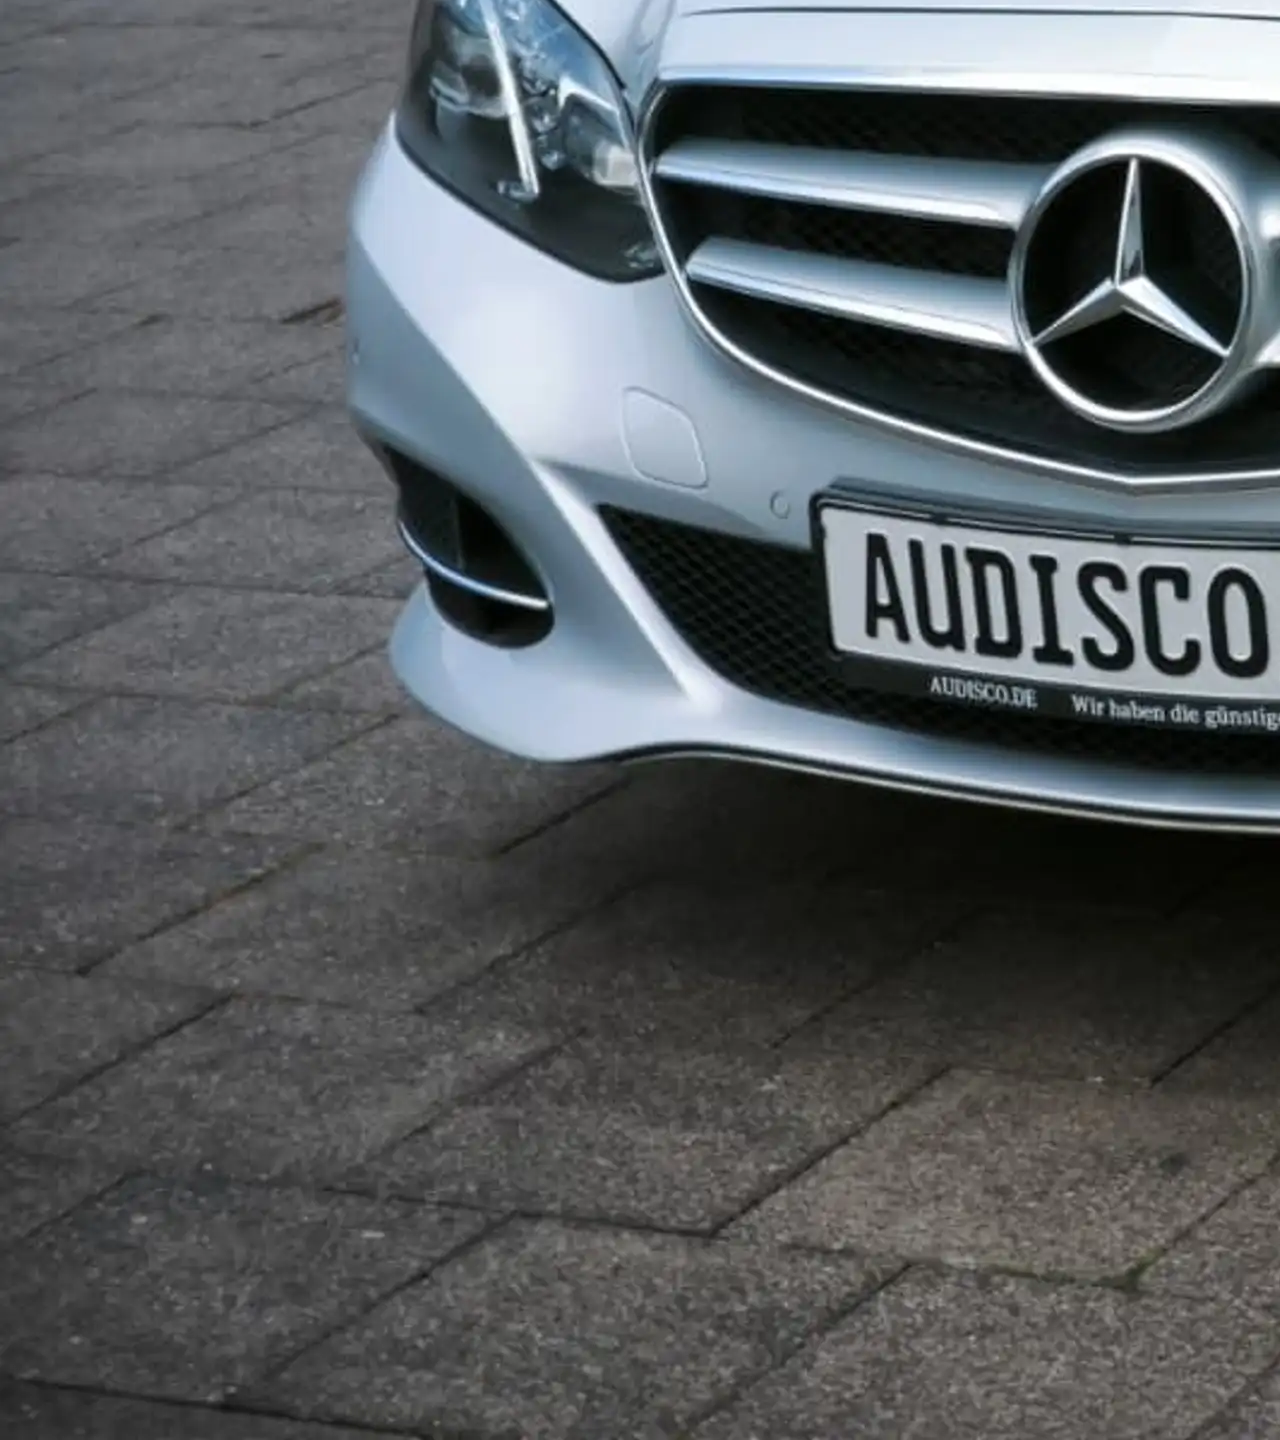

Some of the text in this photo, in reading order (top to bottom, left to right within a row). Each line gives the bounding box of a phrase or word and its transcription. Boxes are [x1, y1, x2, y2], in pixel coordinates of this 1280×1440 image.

[929, 674, 1039, 709] AUDISCO.DE
[1071, 693, 1105, 717] Wir
[1108, 700, 1165, 723] haben
[1170, 703, 1200, 725] die
